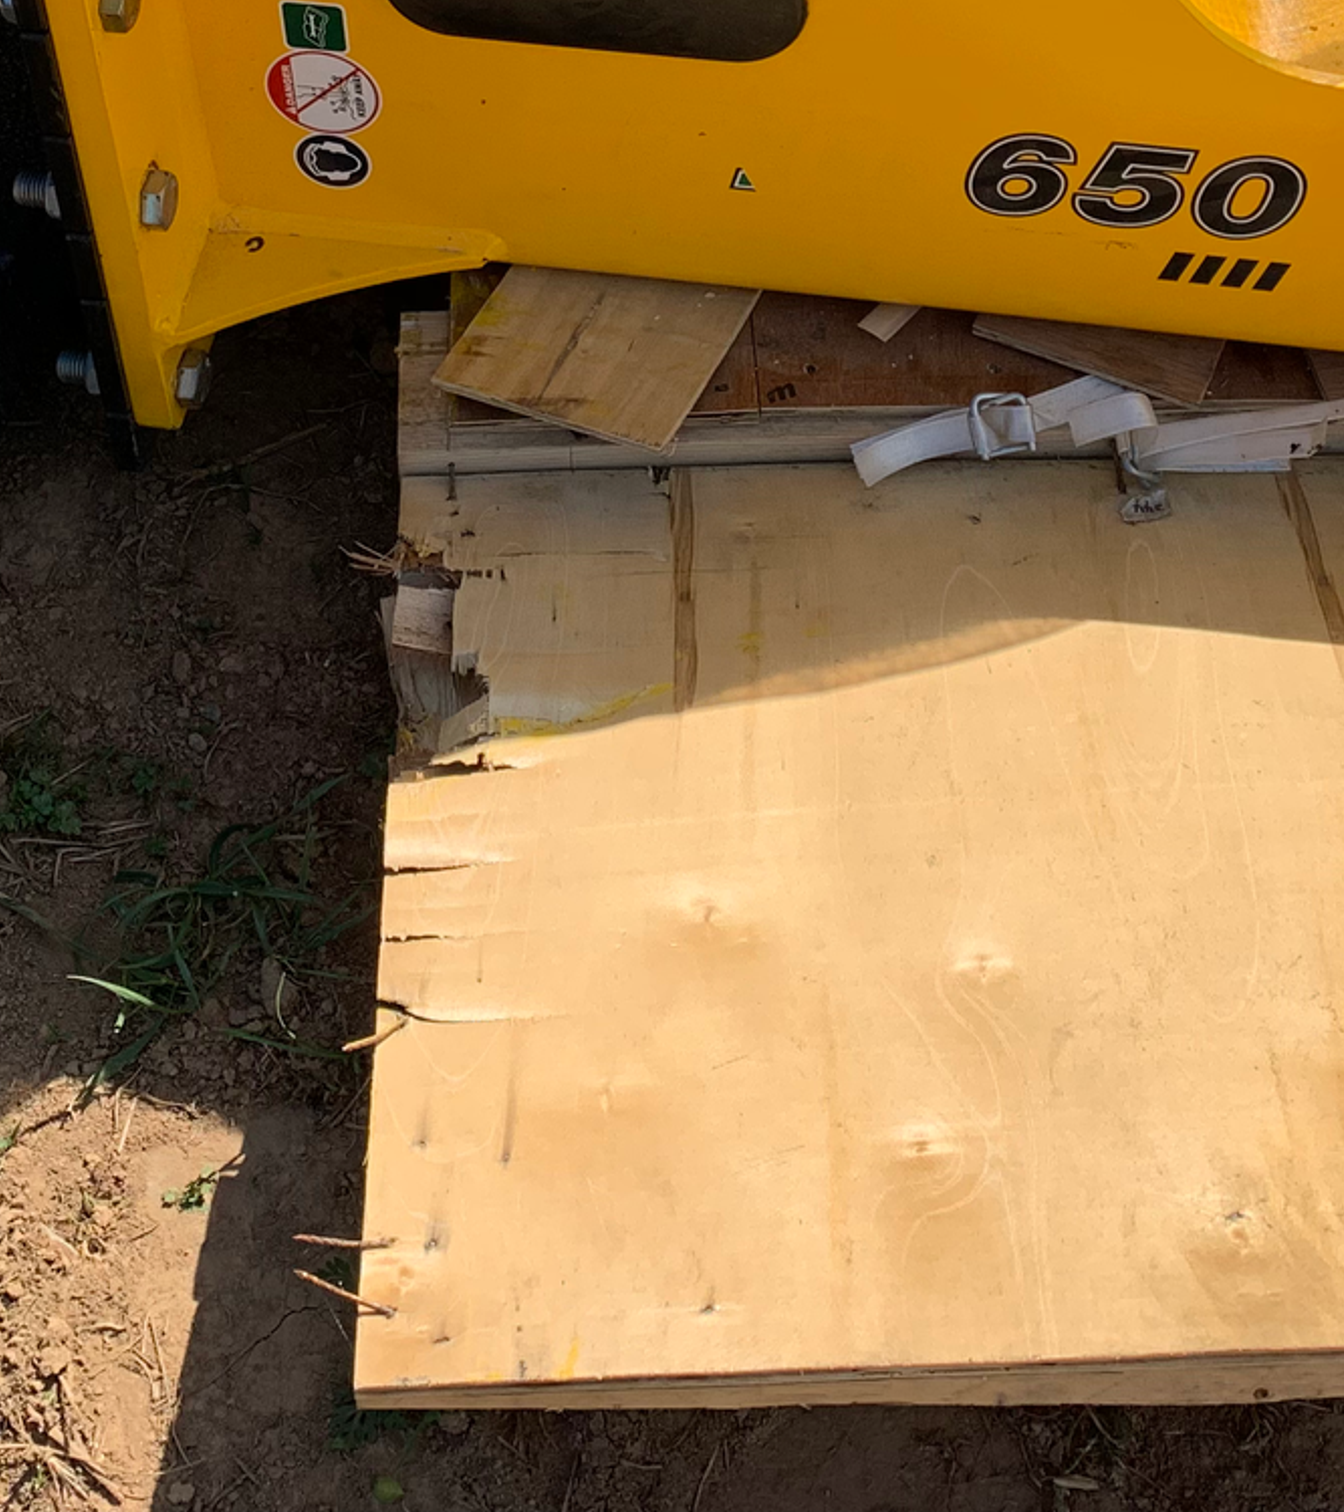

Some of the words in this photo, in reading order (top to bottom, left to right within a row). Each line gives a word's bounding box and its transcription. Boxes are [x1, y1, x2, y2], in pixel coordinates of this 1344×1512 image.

[280, 64, 296, 105] DANGER
[355, 96, 367, 117] KEEP
[965, 133, 1308, 240] 650
